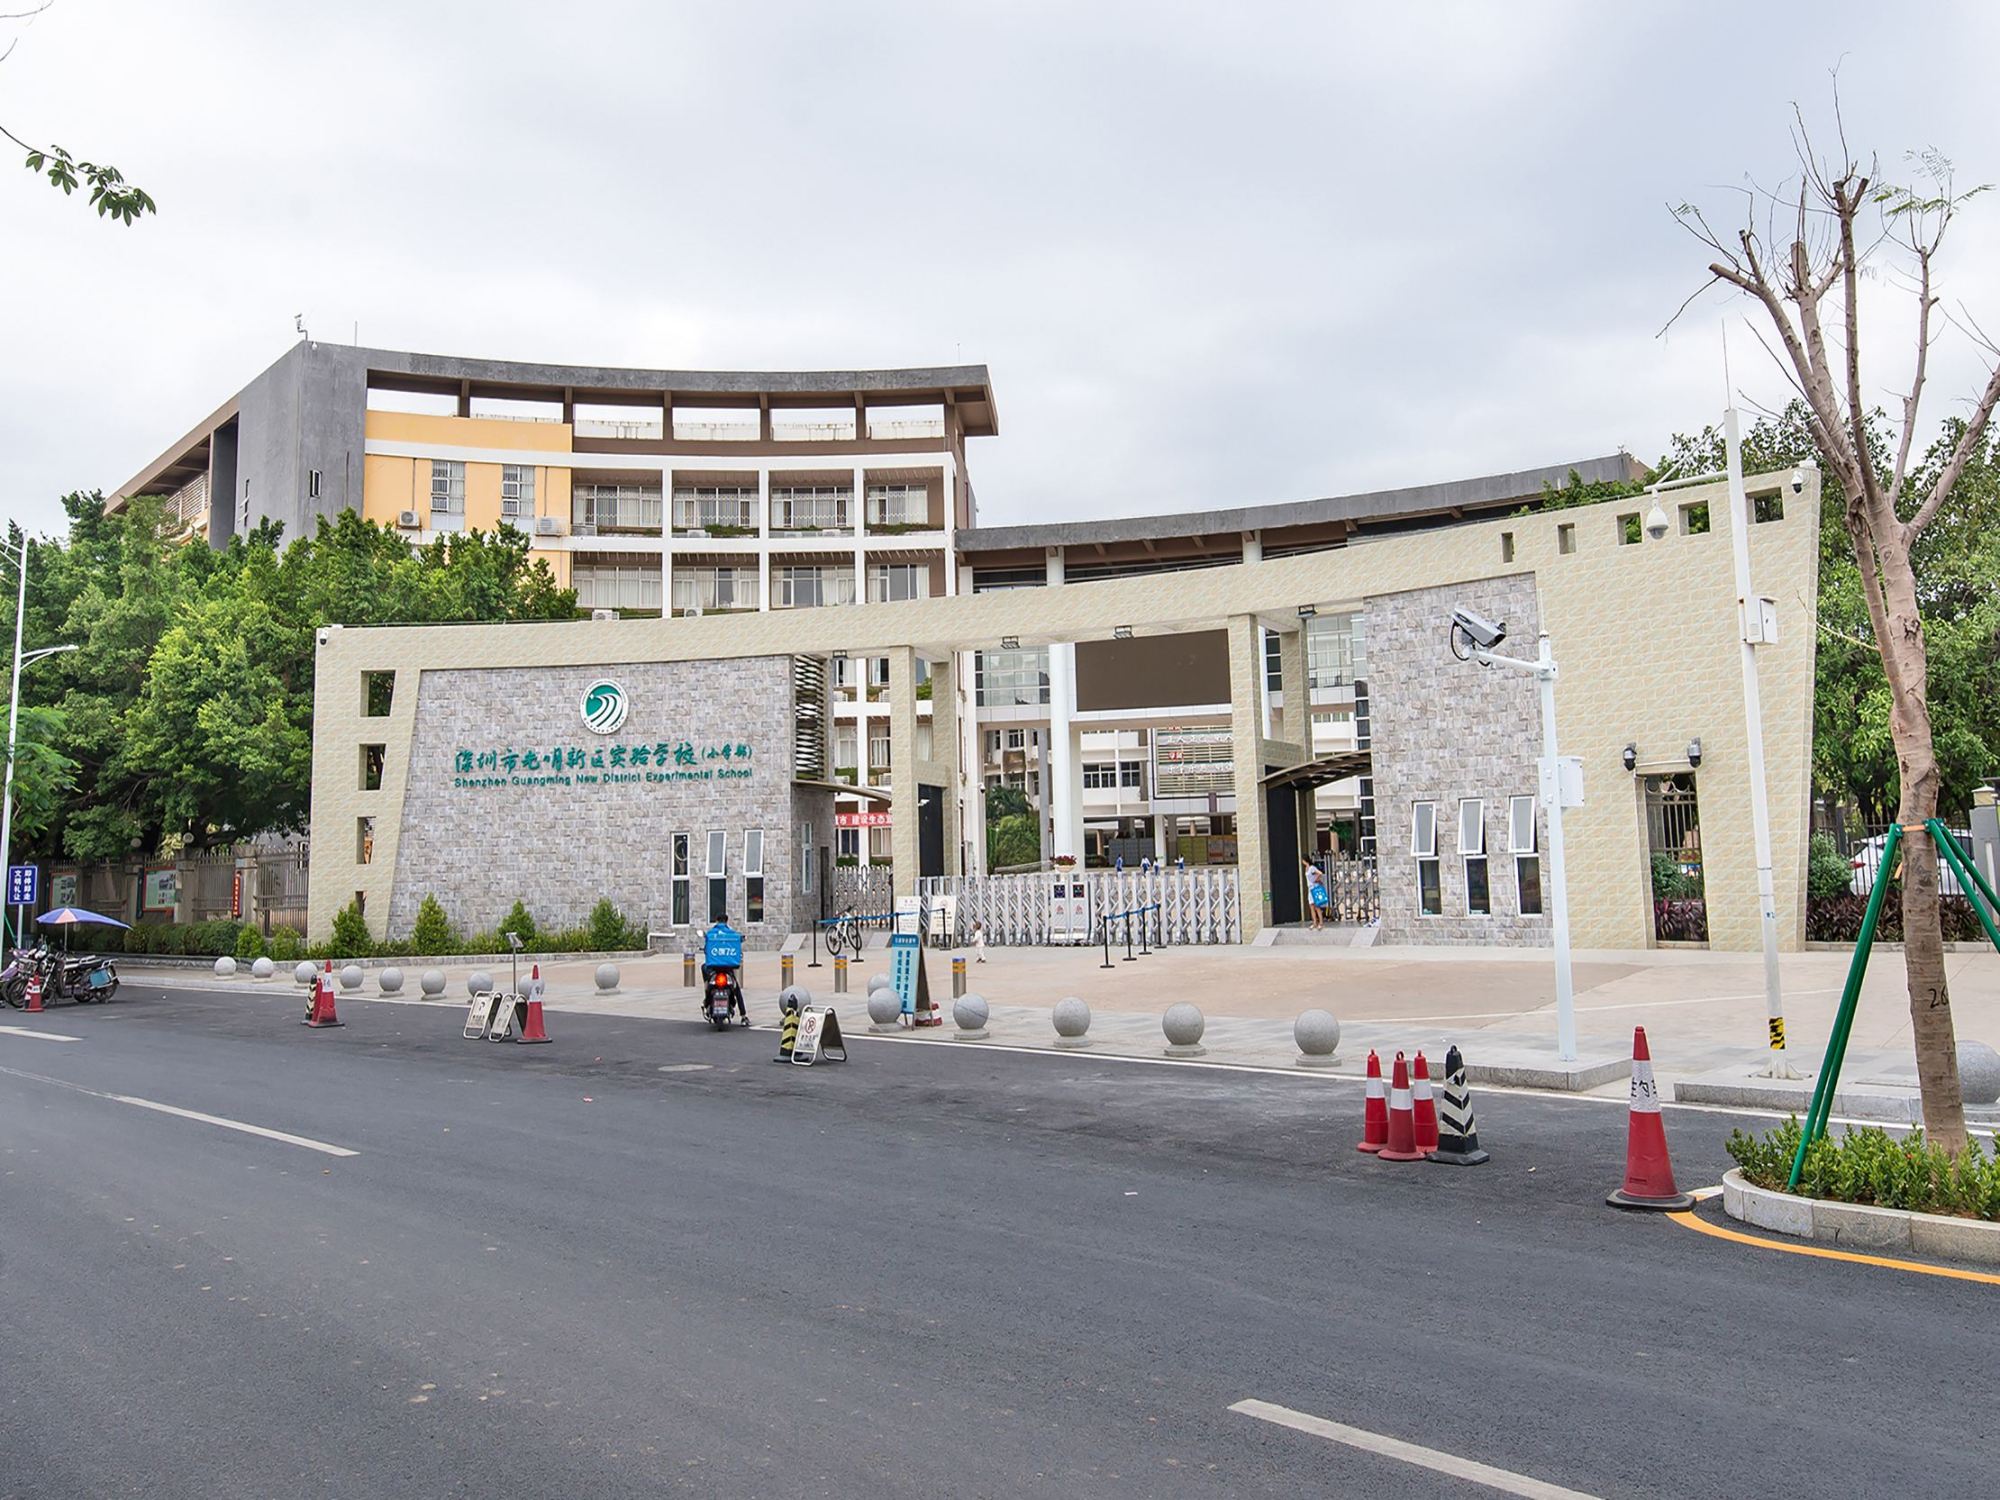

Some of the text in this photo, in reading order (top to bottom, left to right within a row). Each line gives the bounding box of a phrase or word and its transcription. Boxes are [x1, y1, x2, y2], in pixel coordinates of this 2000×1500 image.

[454, 768, 752, 788] Shenzhen Guangming New District Experimental School
[14, 870, 22, 900] 文明礼让
[23, 869, 32, 901] 即停即走
[1928, 985, 1949, 1009] 26
